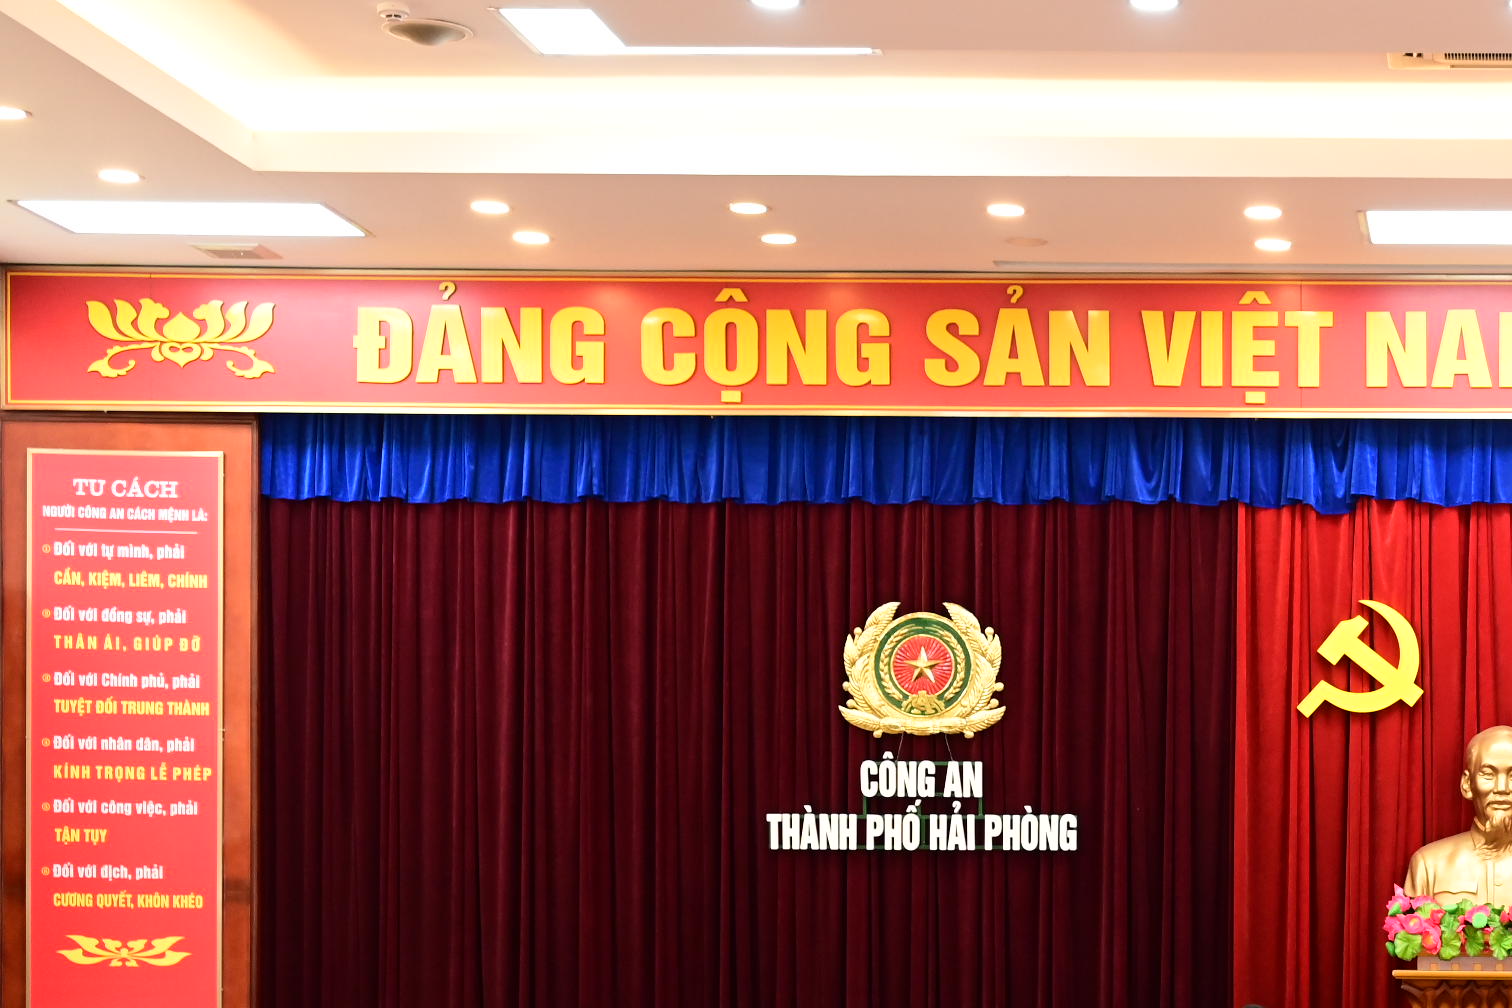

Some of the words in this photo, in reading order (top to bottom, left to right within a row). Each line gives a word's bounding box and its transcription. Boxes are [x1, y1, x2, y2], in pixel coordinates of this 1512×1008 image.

[351, 282, 605, 384] ĐẢNG
[640, 287, 891, 405] CỘNG
[922, 285, 1112, 388] SẢN
[1140, 289, 1334, 405] VIỆT
[111, 476, 179, 498] CÁCH
[78, 505, 106, 519] CÔNG
[109, 508, 124, 519] AN
[127, 506, 155, 520] CÁCH
[89, 570, 125, 589] KIỆM,
[129, 571, 164, 589] LIÊM,
[168, 572, 208, 588] CHÍNH
[861, 751, 935, 797] CÔNG
[943, 761, 982, 797] AN
[767, 805, 857, 850] THÀNH
[866, 799, 921, 850] PHỐ
[930, 801, 975, 850] HẢI
[985, 806, 1077, 851] PHÒNG
